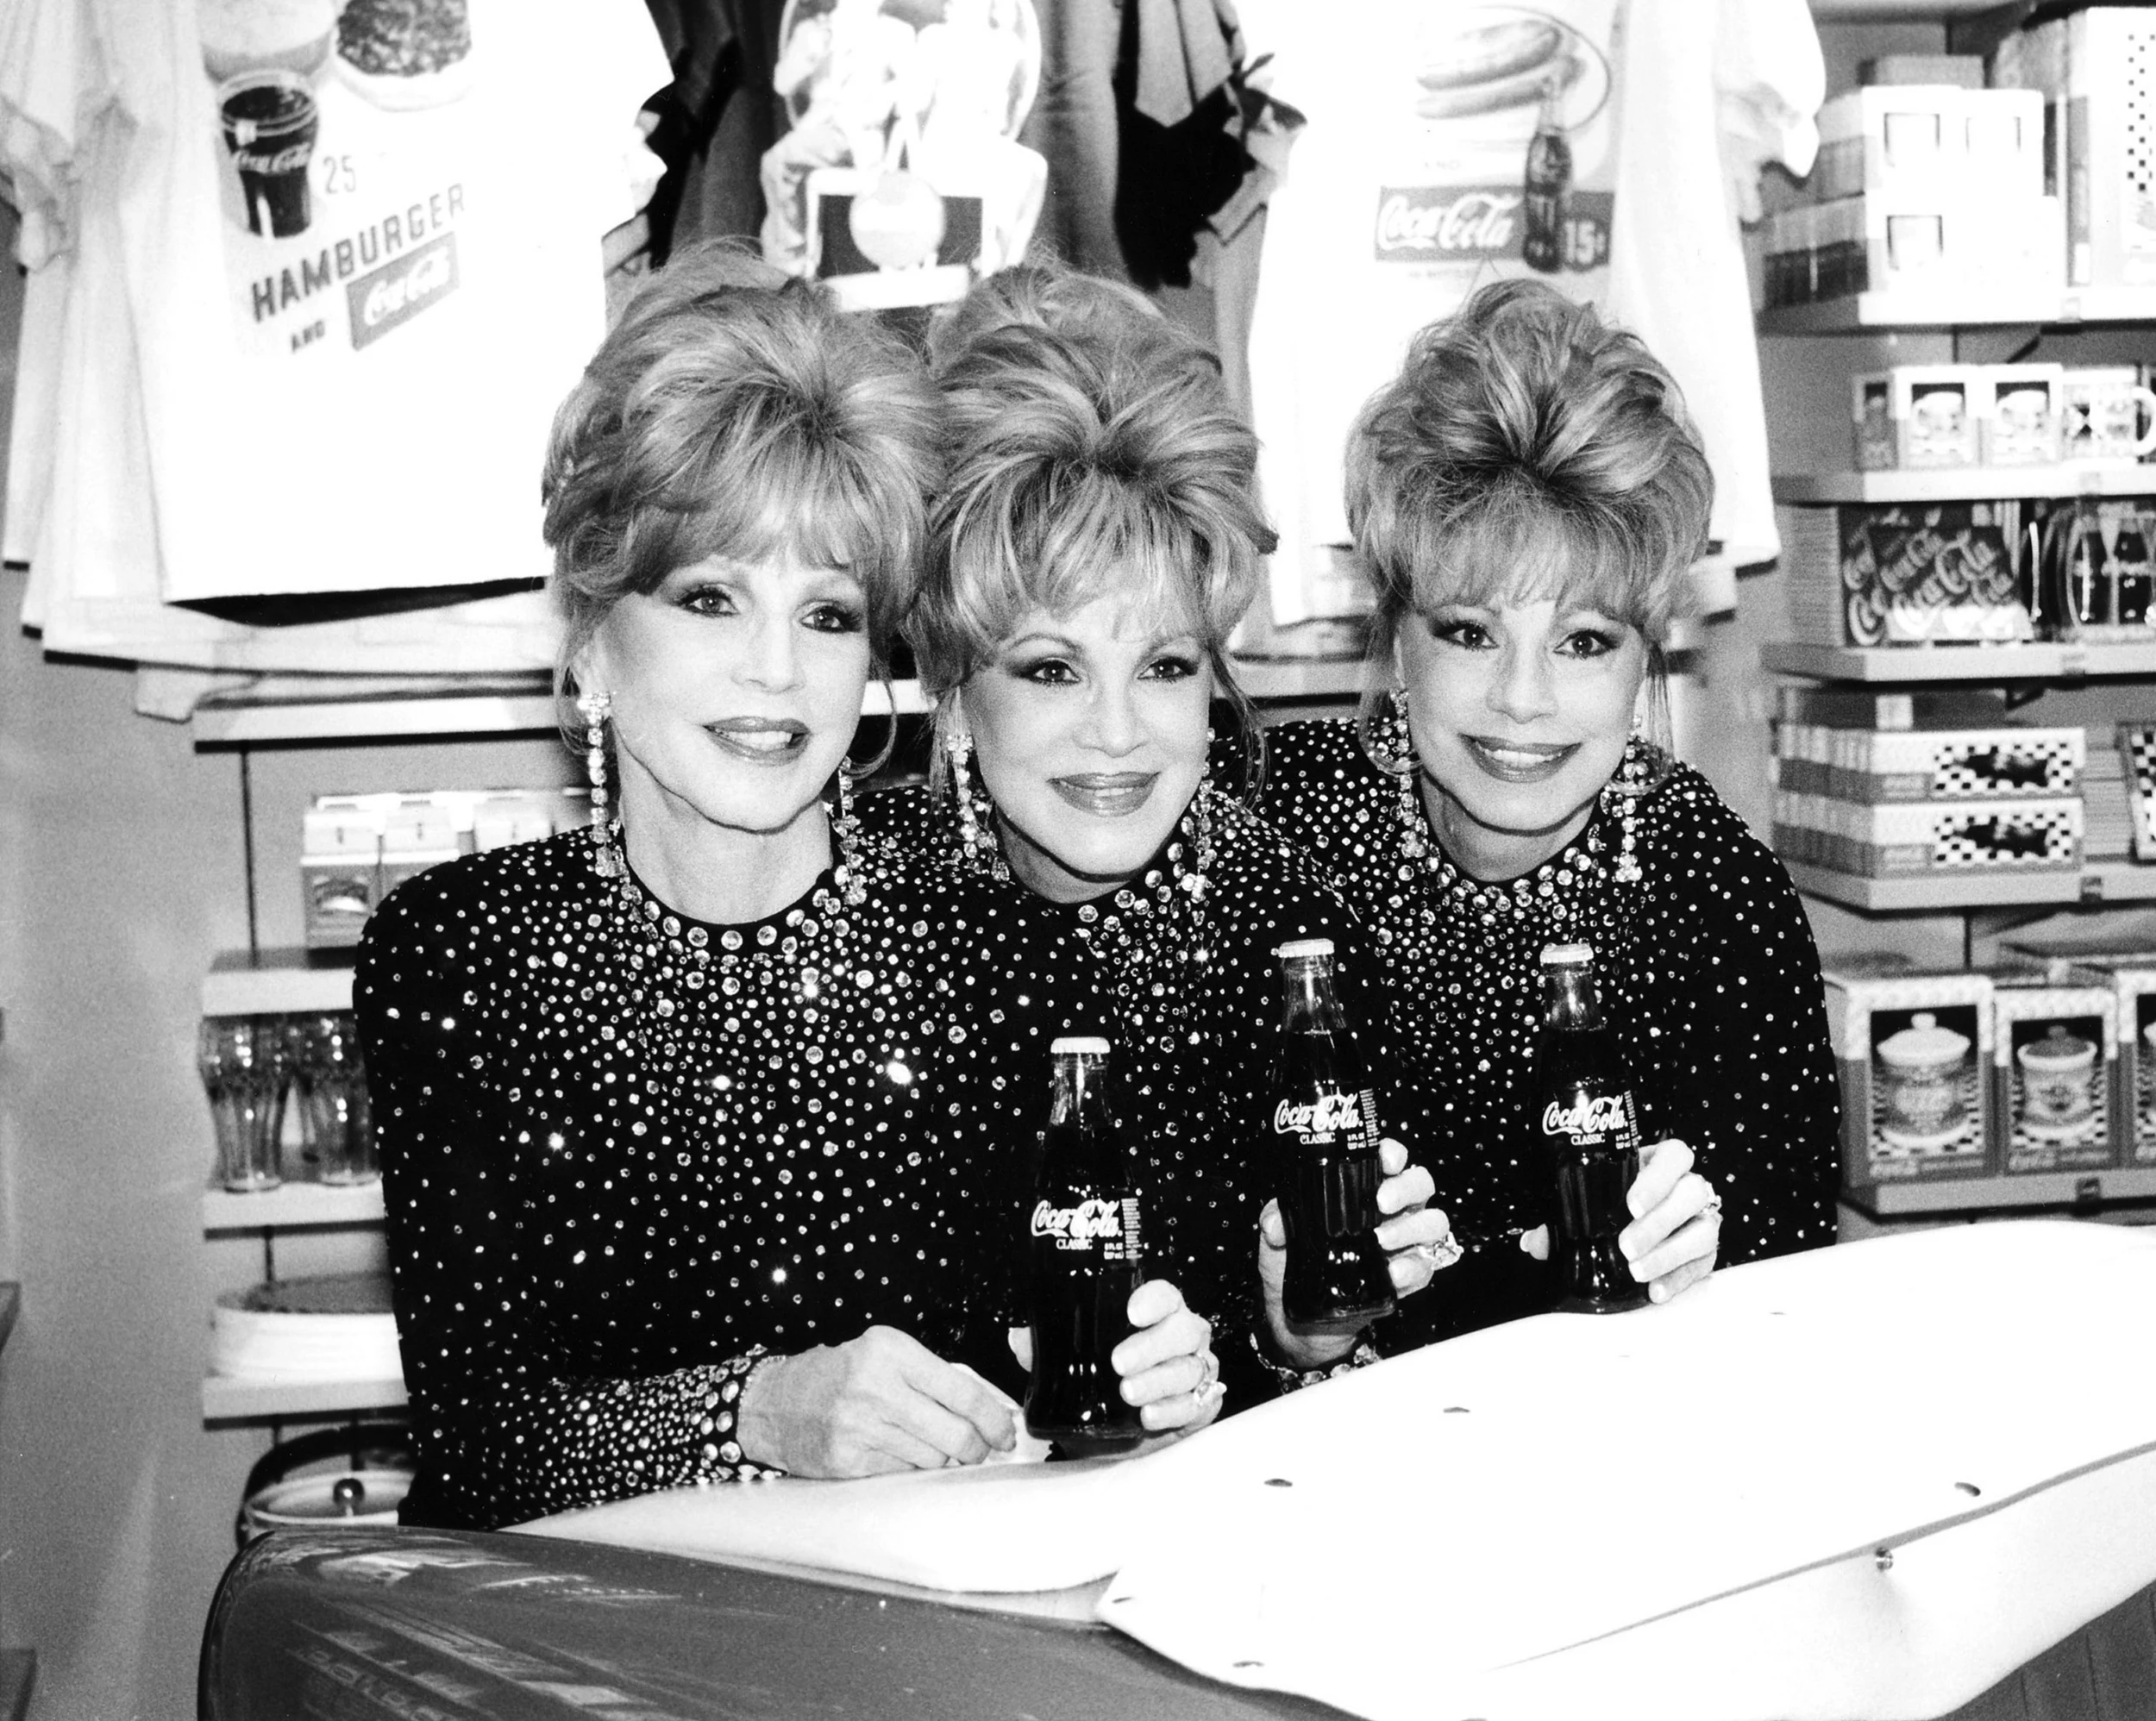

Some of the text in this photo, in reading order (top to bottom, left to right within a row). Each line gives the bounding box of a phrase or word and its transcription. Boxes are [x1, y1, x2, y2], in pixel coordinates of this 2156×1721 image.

[323, 154, 357, 194] 25
[251, 183, 465, 322] HAMBURGER
[291, 320, 326, 353] AND
[1274, 1092, 1362, 1135] Coca-Cola
[1543, 1094, 1627, 1136] Coca-Cola
[1300, 1132, 1336, 1145] CLASSIC
[1570, 1132, 1606, 1146] CLASSIC
[1031, 1198, 1122, 1238] Coca-Cola
[1055, 1237, 1094, 1250] CLASSIC
